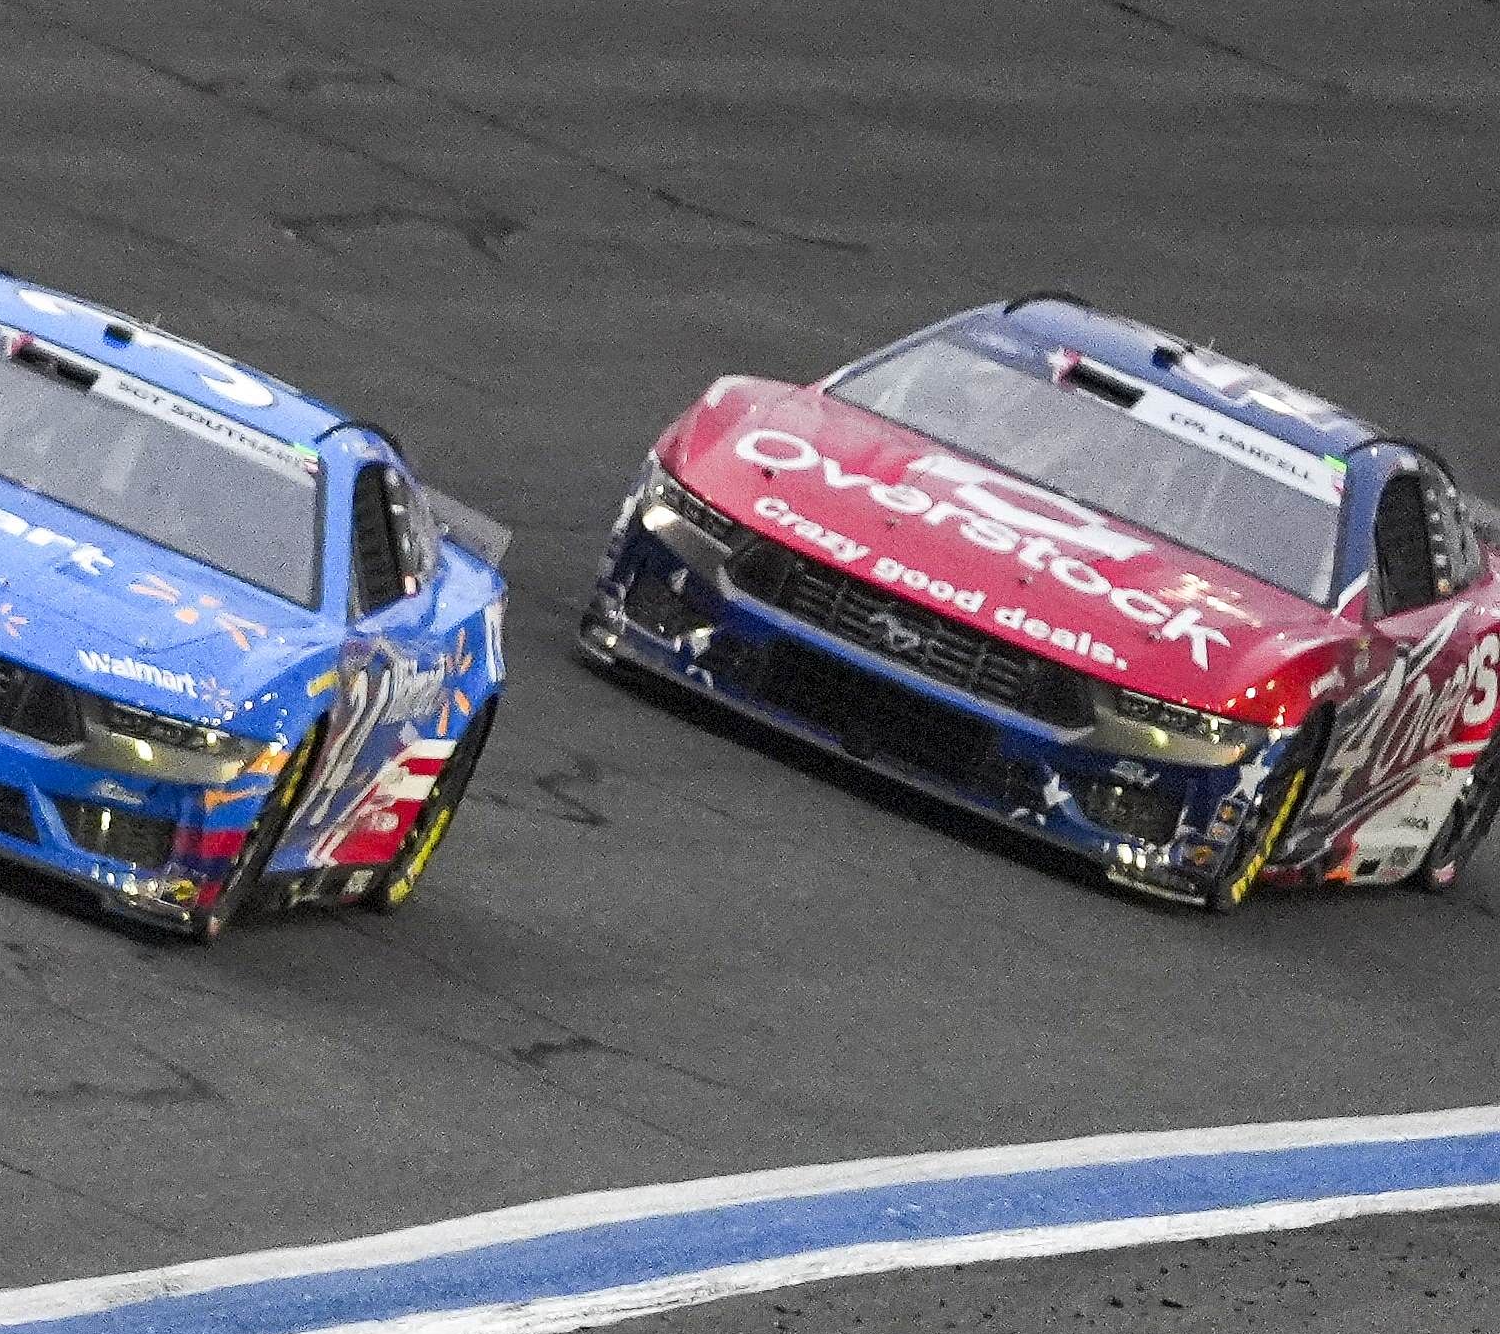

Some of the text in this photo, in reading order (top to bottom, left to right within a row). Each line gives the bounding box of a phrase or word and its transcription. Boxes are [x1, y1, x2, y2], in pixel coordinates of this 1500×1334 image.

[734, 428, 1232, 673] Overstock
[752, 495, 1129, 672] Crazy good deals.
[76, 649, 198, 700] Walmart
